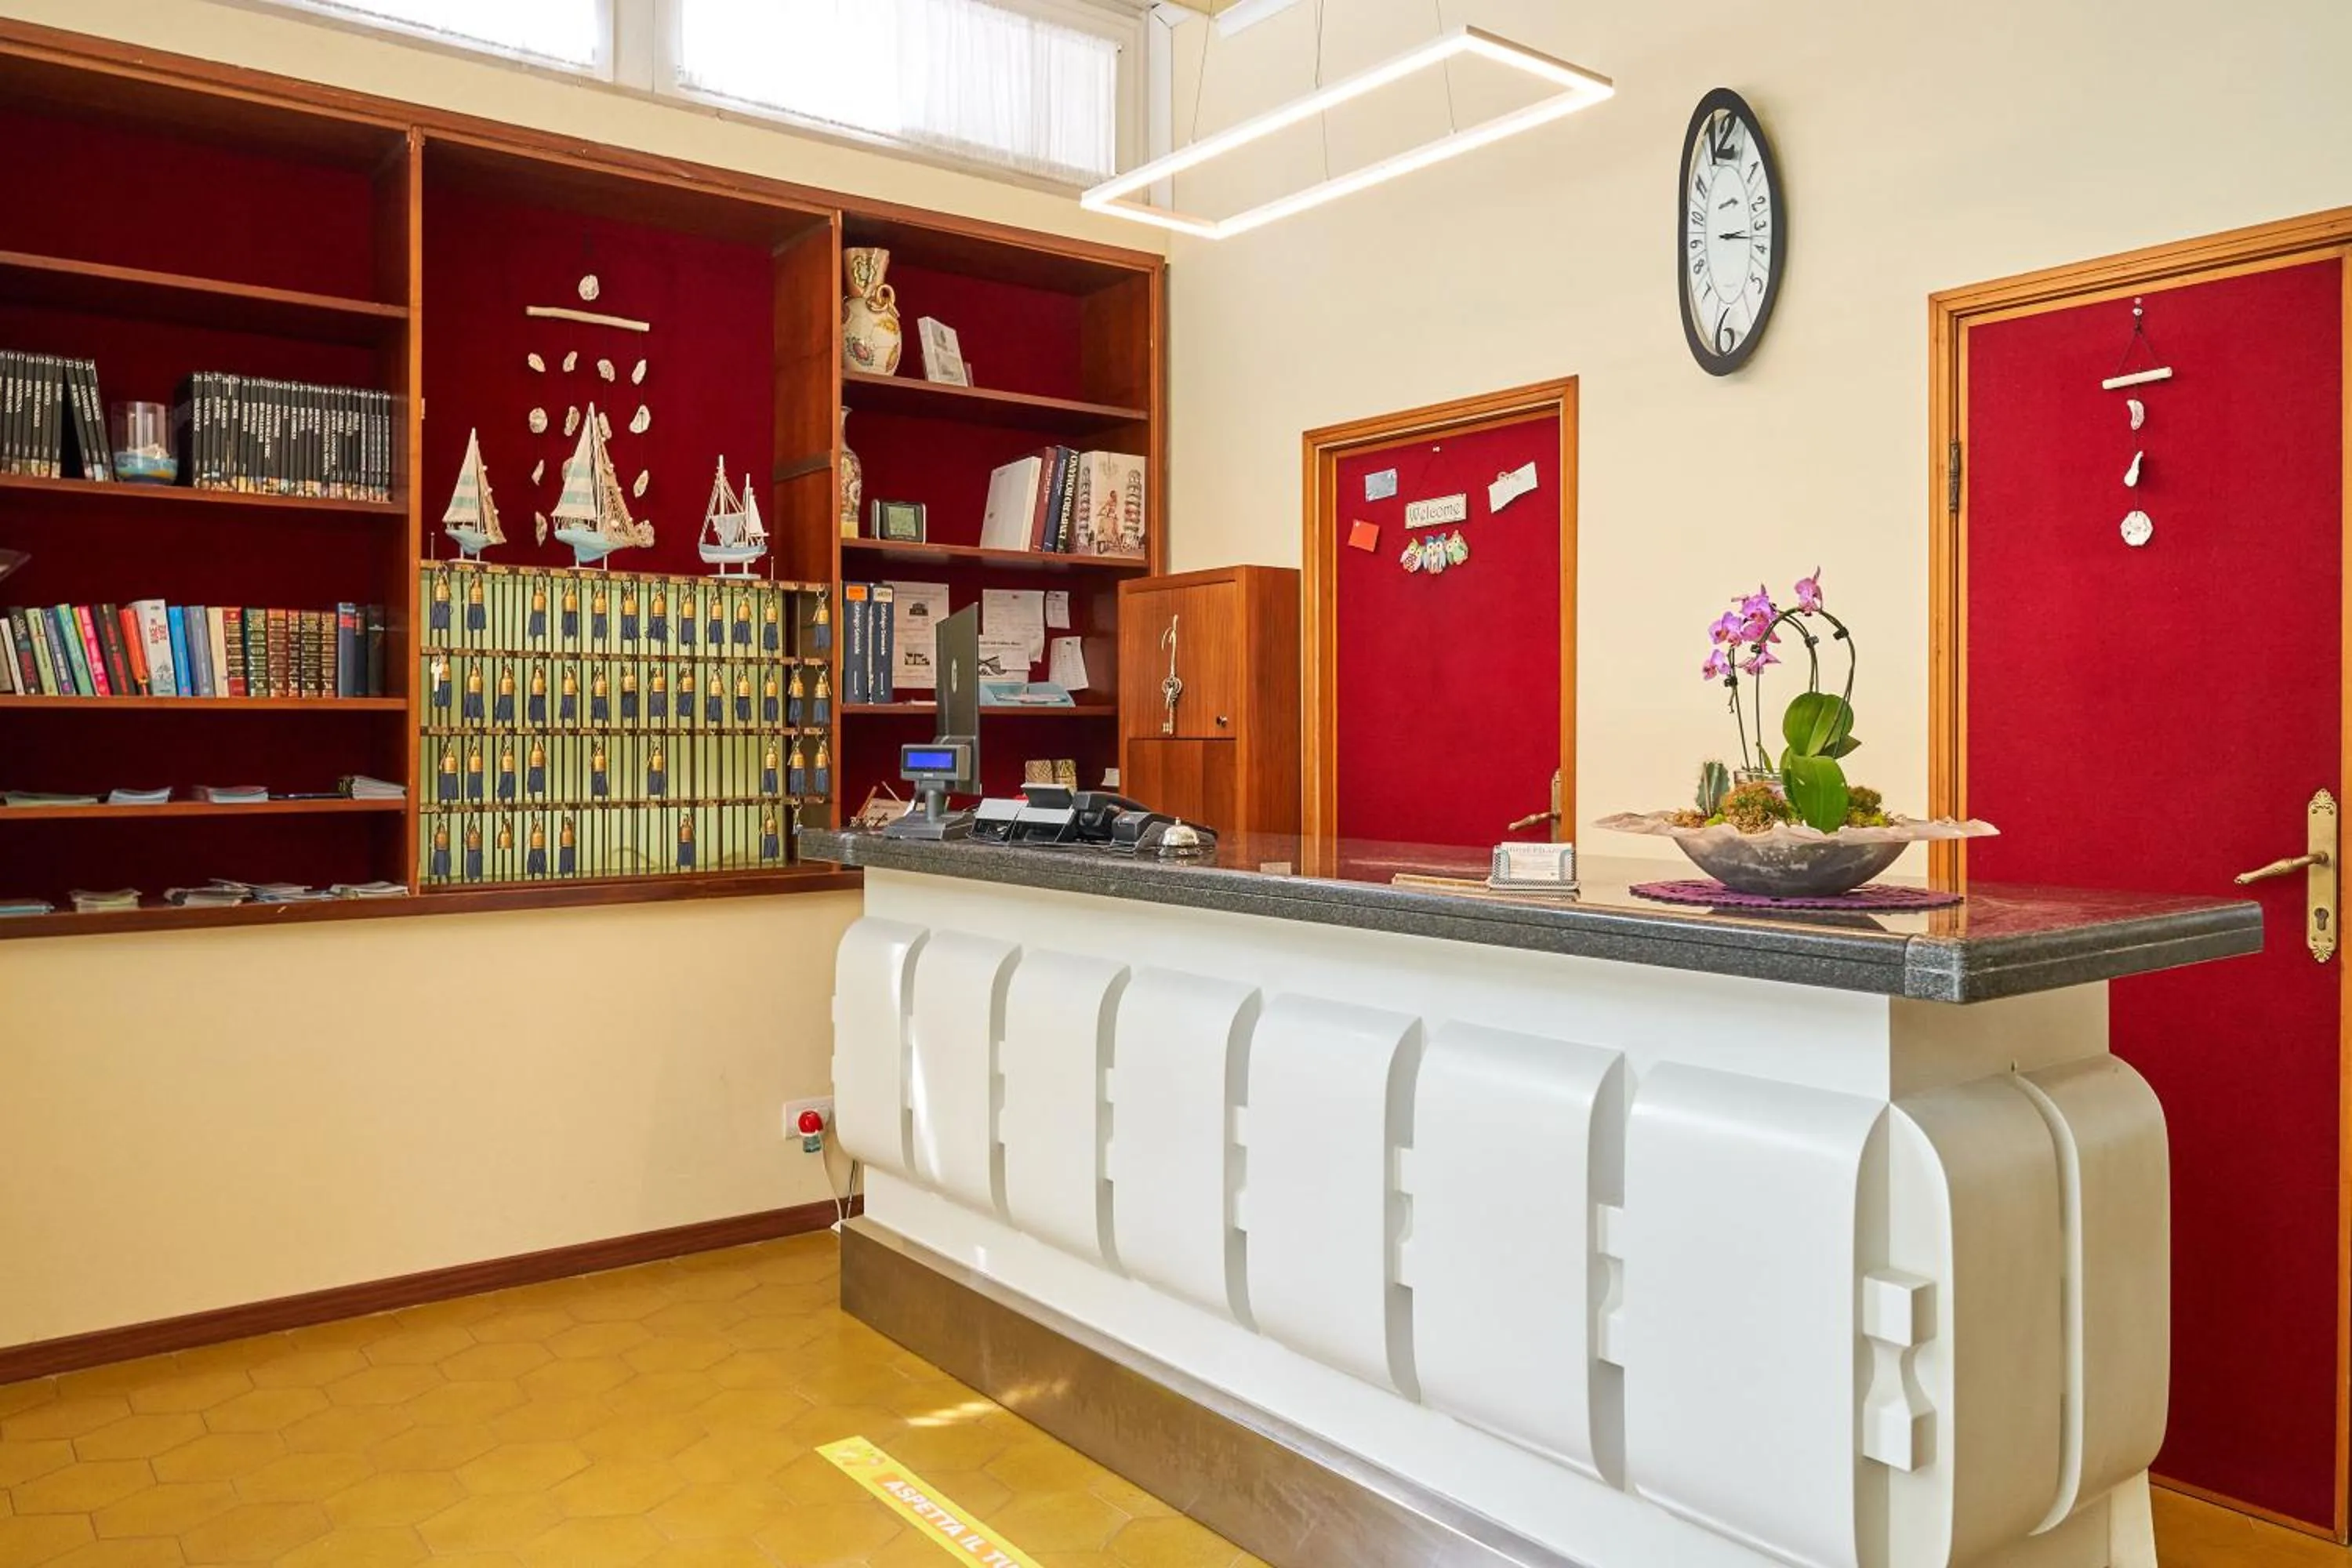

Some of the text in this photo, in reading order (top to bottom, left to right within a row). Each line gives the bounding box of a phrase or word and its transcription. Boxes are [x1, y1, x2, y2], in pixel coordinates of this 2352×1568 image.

[1704, 112, 1737, 165] 12
[1751, 195, 1766, 212] 2
[1691, 211, 1704, 227] 10
[1754, 220, 1766, 231] 3
[1693, 258, 1704, 274] 8
[1749, 271, 1763, 294] 5
[1715, 307, 1735, 355] 6
[1409, 503, 1461, 521] Welcome
[883, 1481, 967, 1537] ASPETTA
[959, 1534, 988, 1552] IL
